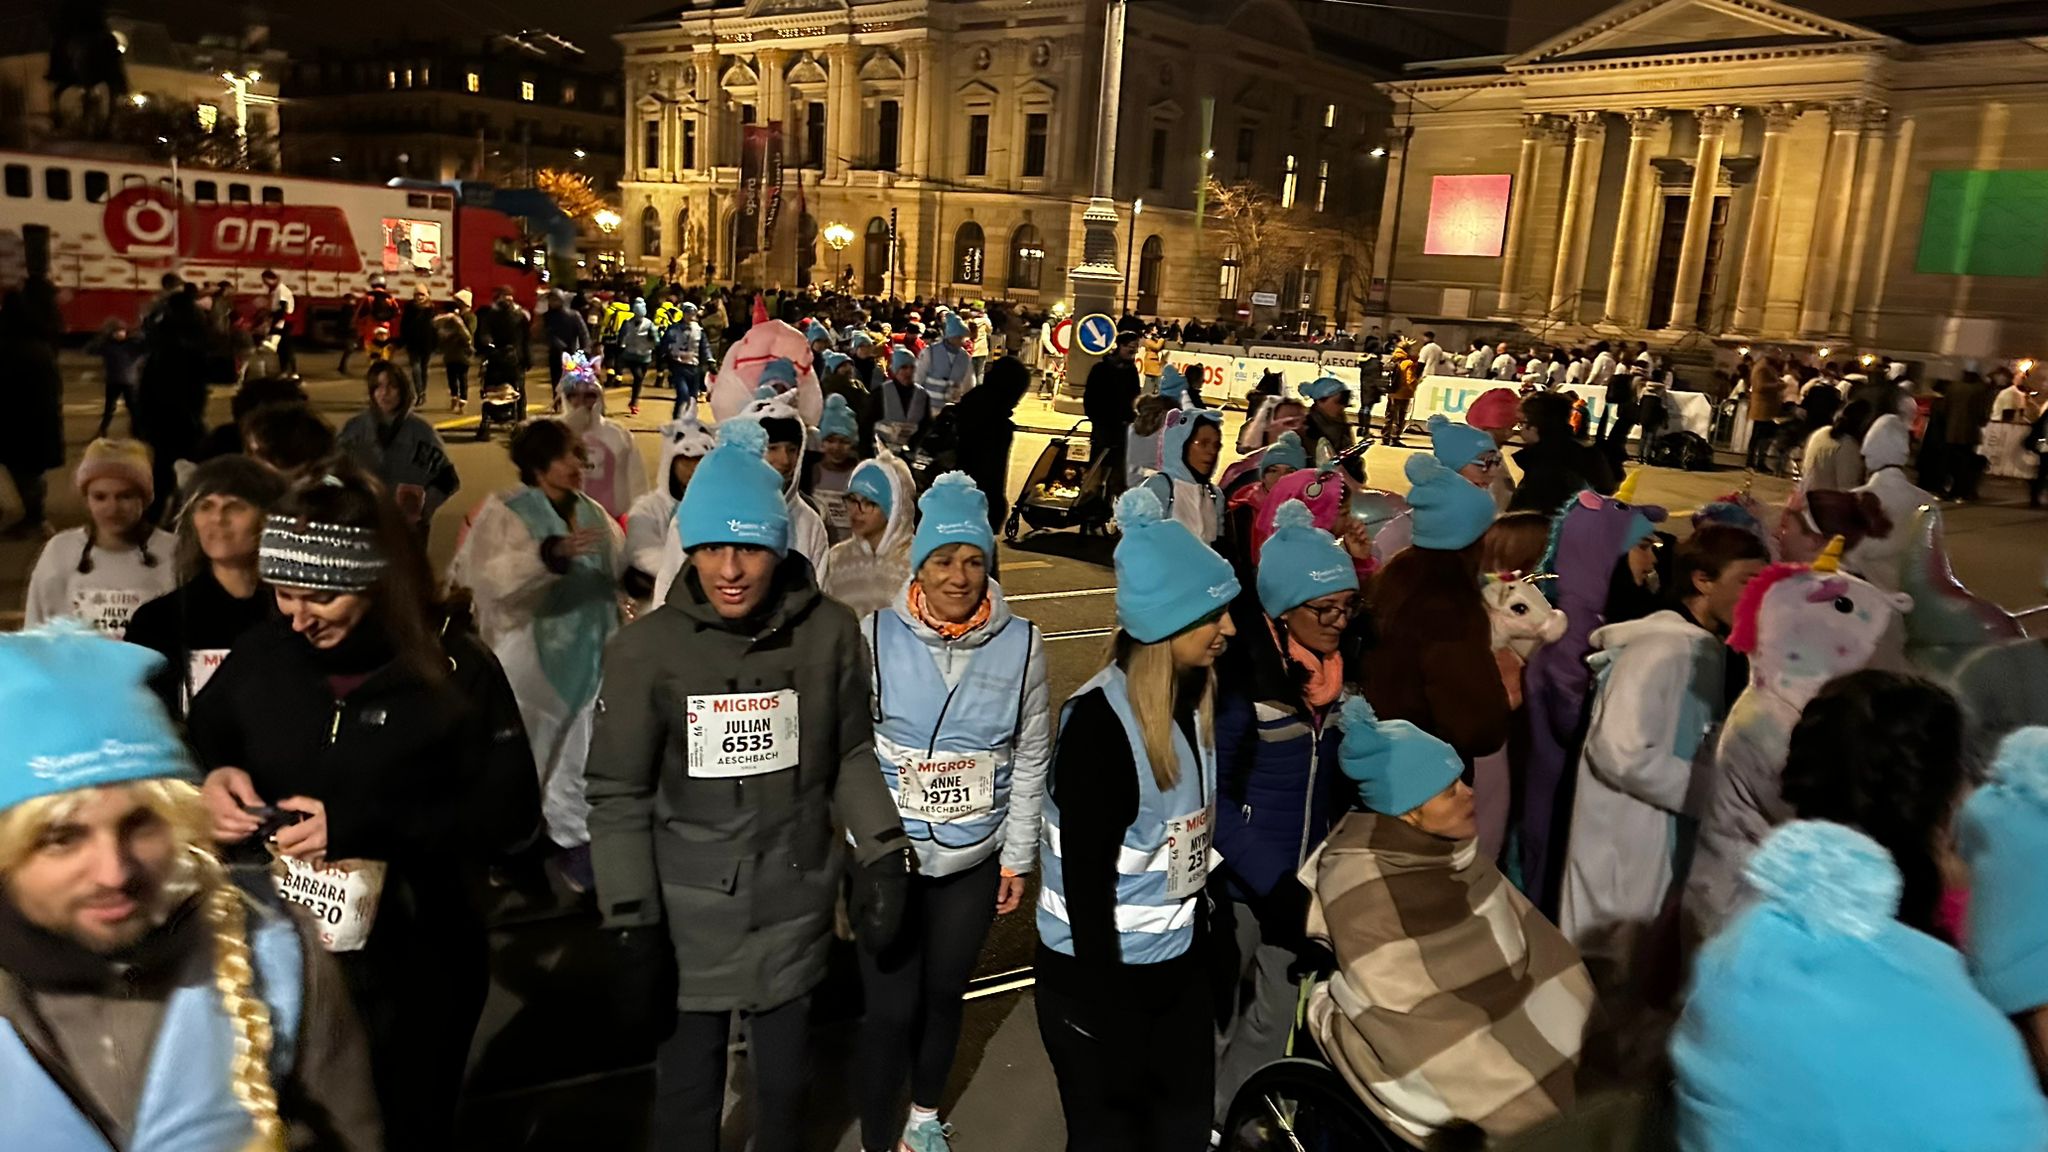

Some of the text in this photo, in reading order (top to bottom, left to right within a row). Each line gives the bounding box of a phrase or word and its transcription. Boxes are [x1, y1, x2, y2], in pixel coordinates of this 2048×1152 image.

[713, 696, 780, 713] MIGROS
[724, 718, 771, 734] JULIAN
[722, 733, 774, 753] 6535
[717, 751, 779, 765] AESCHBACH
[918, 759, 976, 773] MIGROS
[930, 776, 962, 789] ANNE
[920, 805, 972, 813] AESCHBACH
[283, 873, 346, 904] BARBARA
